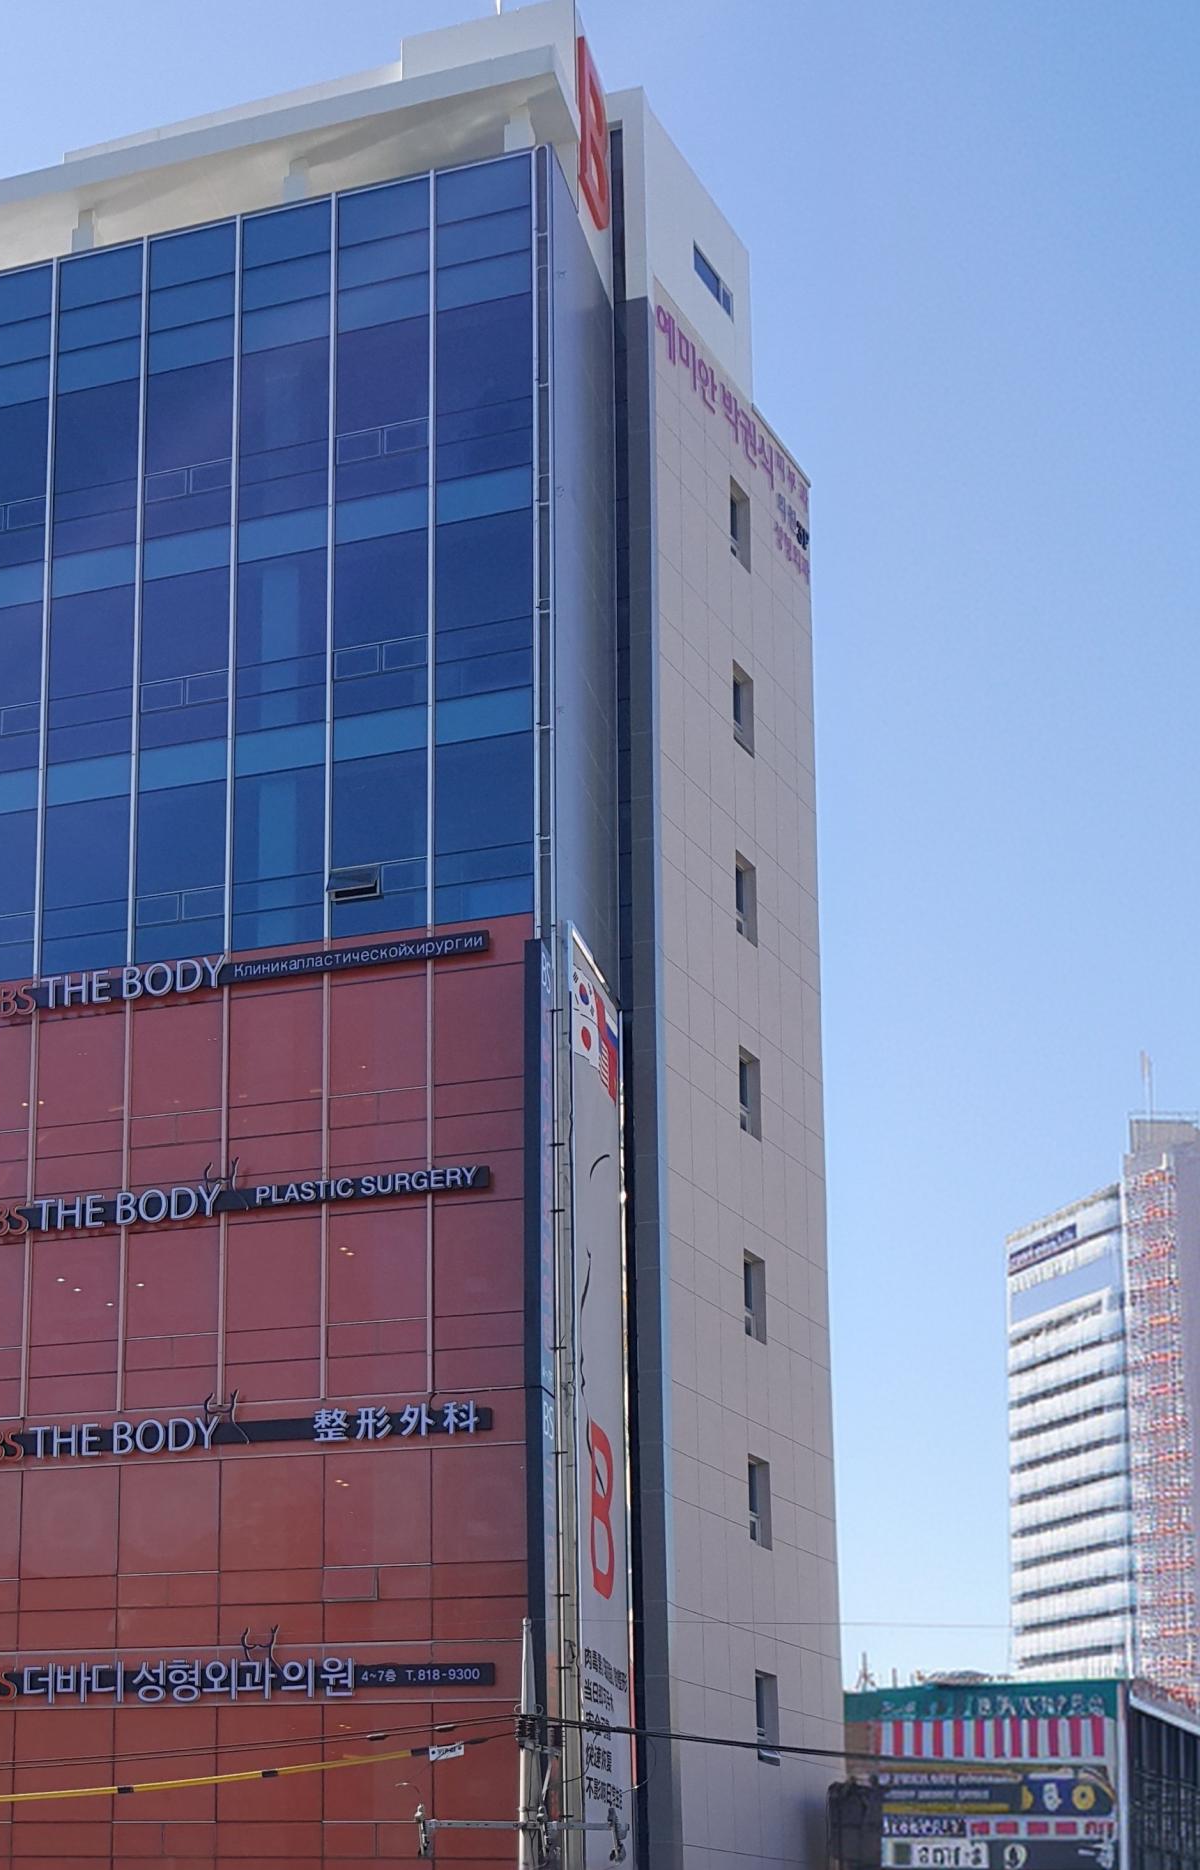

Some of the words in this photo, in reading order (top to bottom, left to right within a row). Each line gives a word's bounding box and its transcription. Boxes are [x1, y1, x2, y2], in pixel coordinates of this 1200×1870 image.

[657, 305, 717, 415] 예미안
[720, 382, 775, 491] 박권식
[0, 984, 38, 1018] BS
[40, 968, 112, 1010] THE
[122, 953, 226, 1001] BODY
[33, 1193, 105, 1233] THE
[115, 1183, 222, 1227] BODY
[255, 1177, 354, 1205] PLASTIC
[360, 1165, 479, 1196] SURGERY
[29, 1422, 102, 1459] THE
[112, 1415, 220, 1456] BODY
[313, 1400, 480, 1442] 整形外科
[22, 1659, 125, 1704] 더바디
[131, 1656, 356, 1704] 성형외과의원
[361, 1669, 398, 1683] 4~7층
[405, 1667, 481, 1682] T.818-9300
